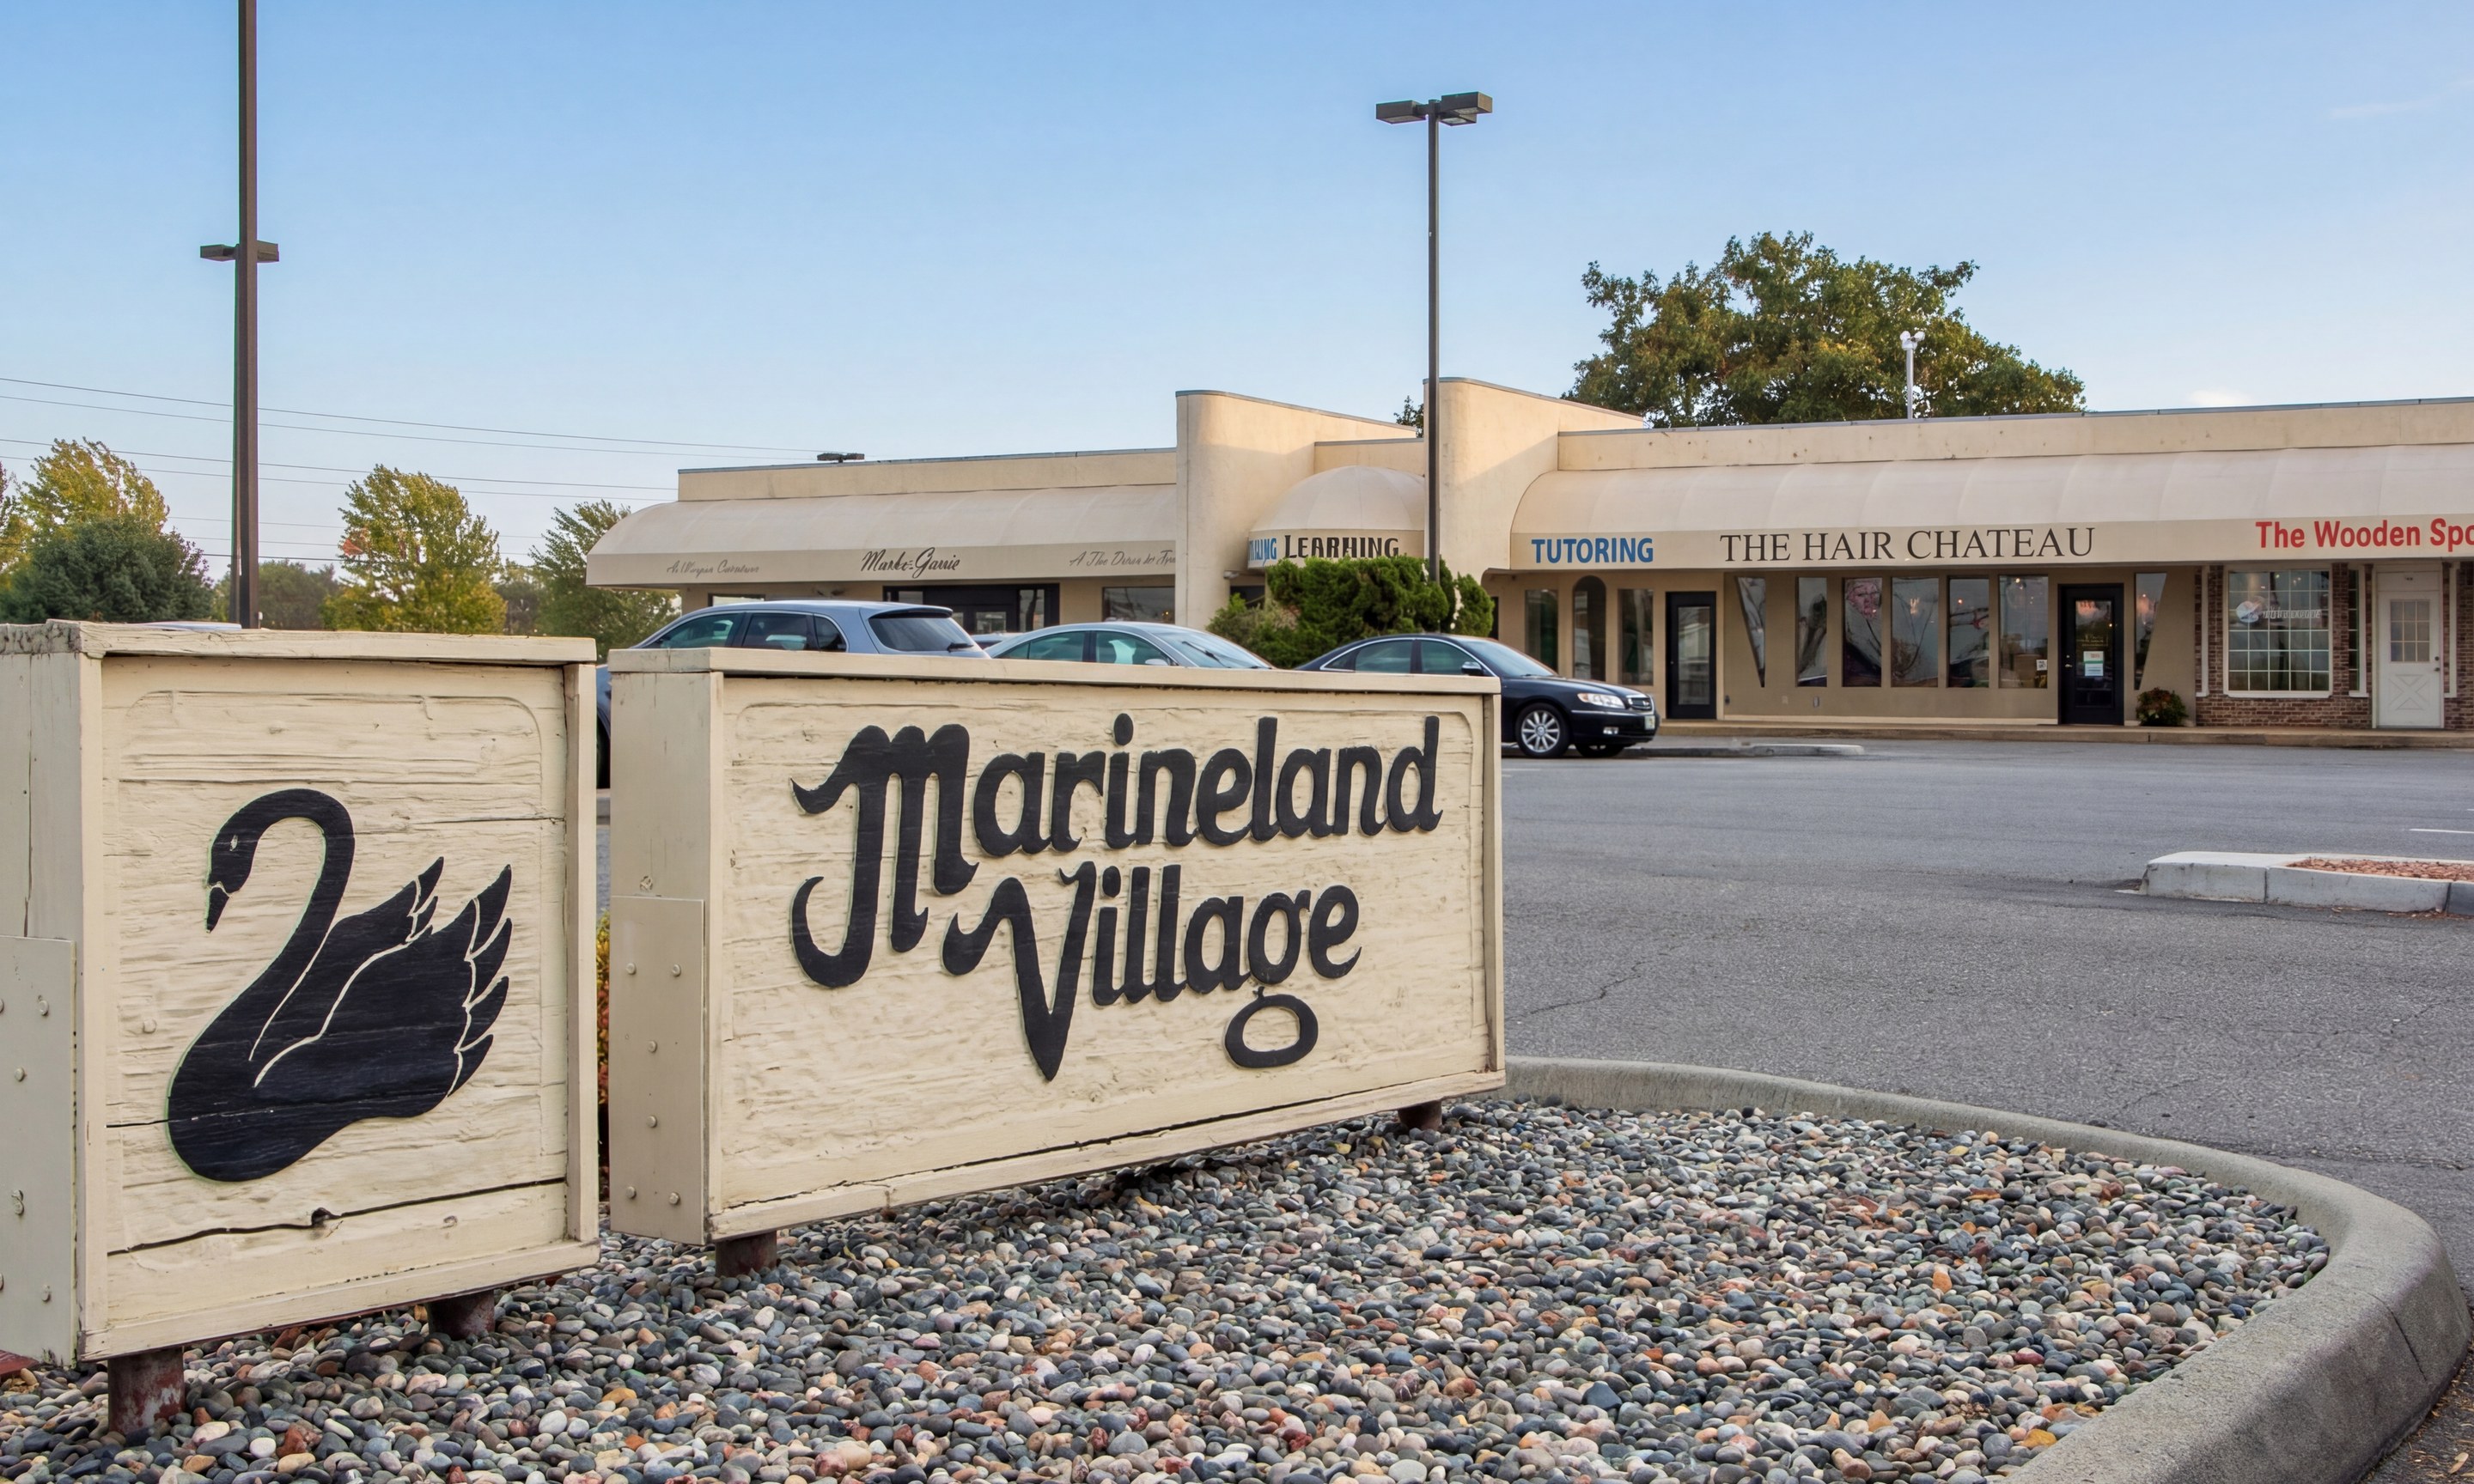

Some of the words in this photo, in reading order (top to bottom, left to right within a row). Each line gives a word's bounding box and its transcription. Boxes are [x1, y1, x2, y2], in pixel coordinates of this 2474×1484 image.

[1532, 538, 1654, 563] TUTORING
[1719, 534, 1791, 562] THE
[1802, 532, 1896, 560] HAIR
[1906, 527, 2095, 559] CHATEAU
[2255, 521, 2305, 548] The
[2314, 520, 2421, 547] Wooden
[791, 713, 1444, 988] Marineland
[942, 861, 1362, 1082] Village
